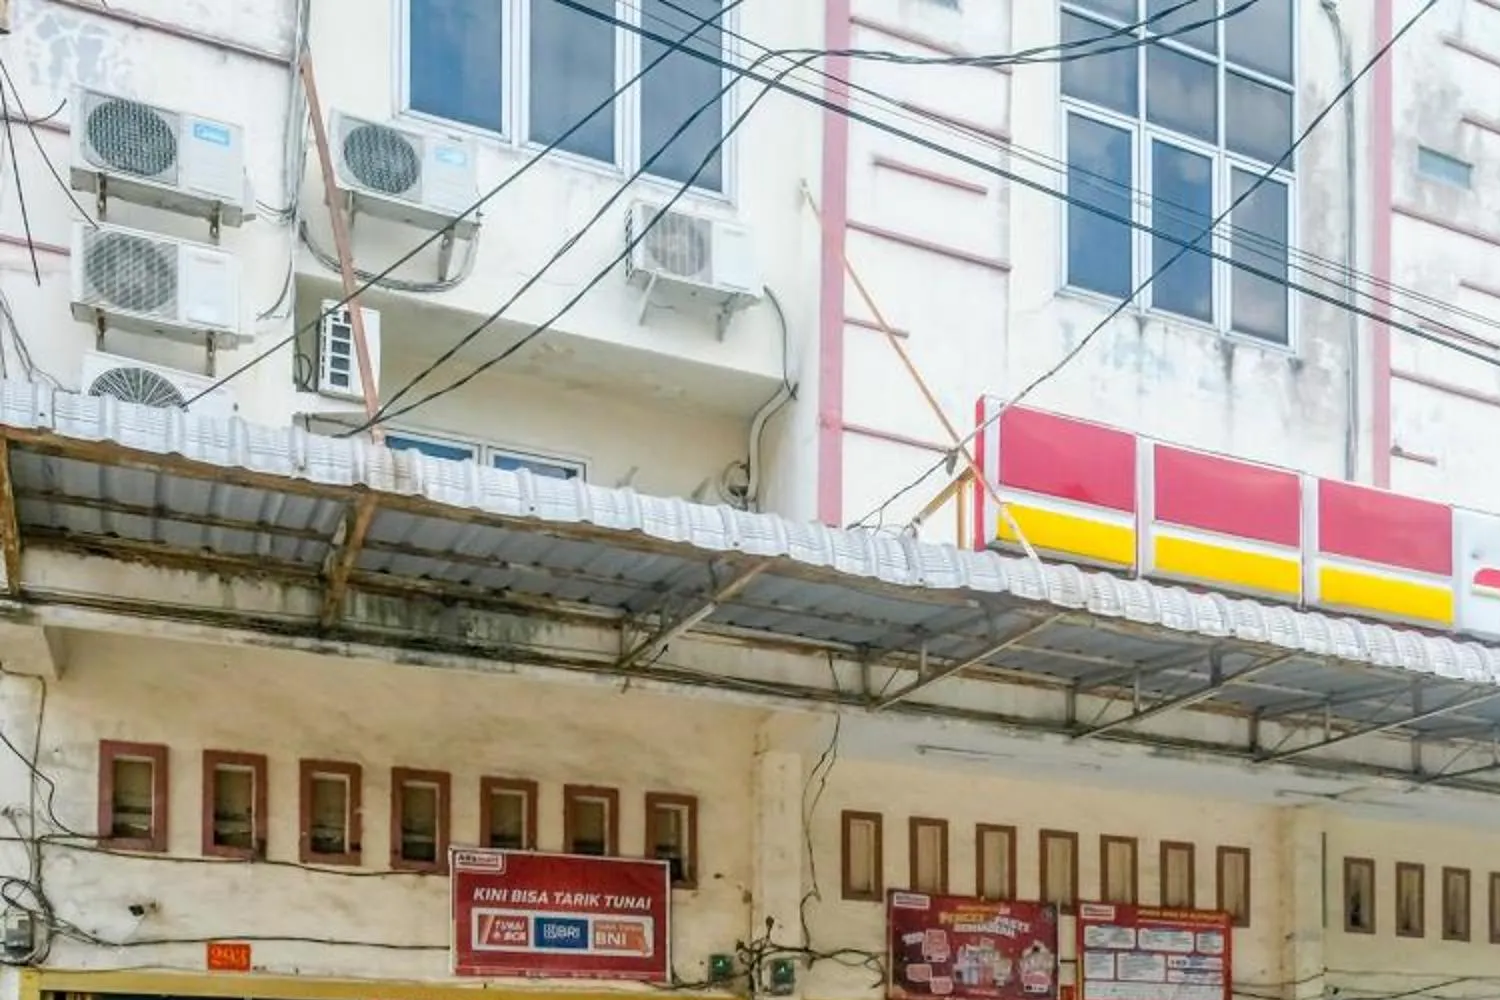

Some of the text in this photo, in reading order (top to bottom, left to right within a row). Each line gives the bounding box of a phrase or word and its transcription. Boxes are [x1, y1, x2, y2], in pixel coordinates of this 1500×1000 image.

[473, 887, 652, 909] KINI BISA TARIK TUNAI
[595, 932, 627, 946] BNI
